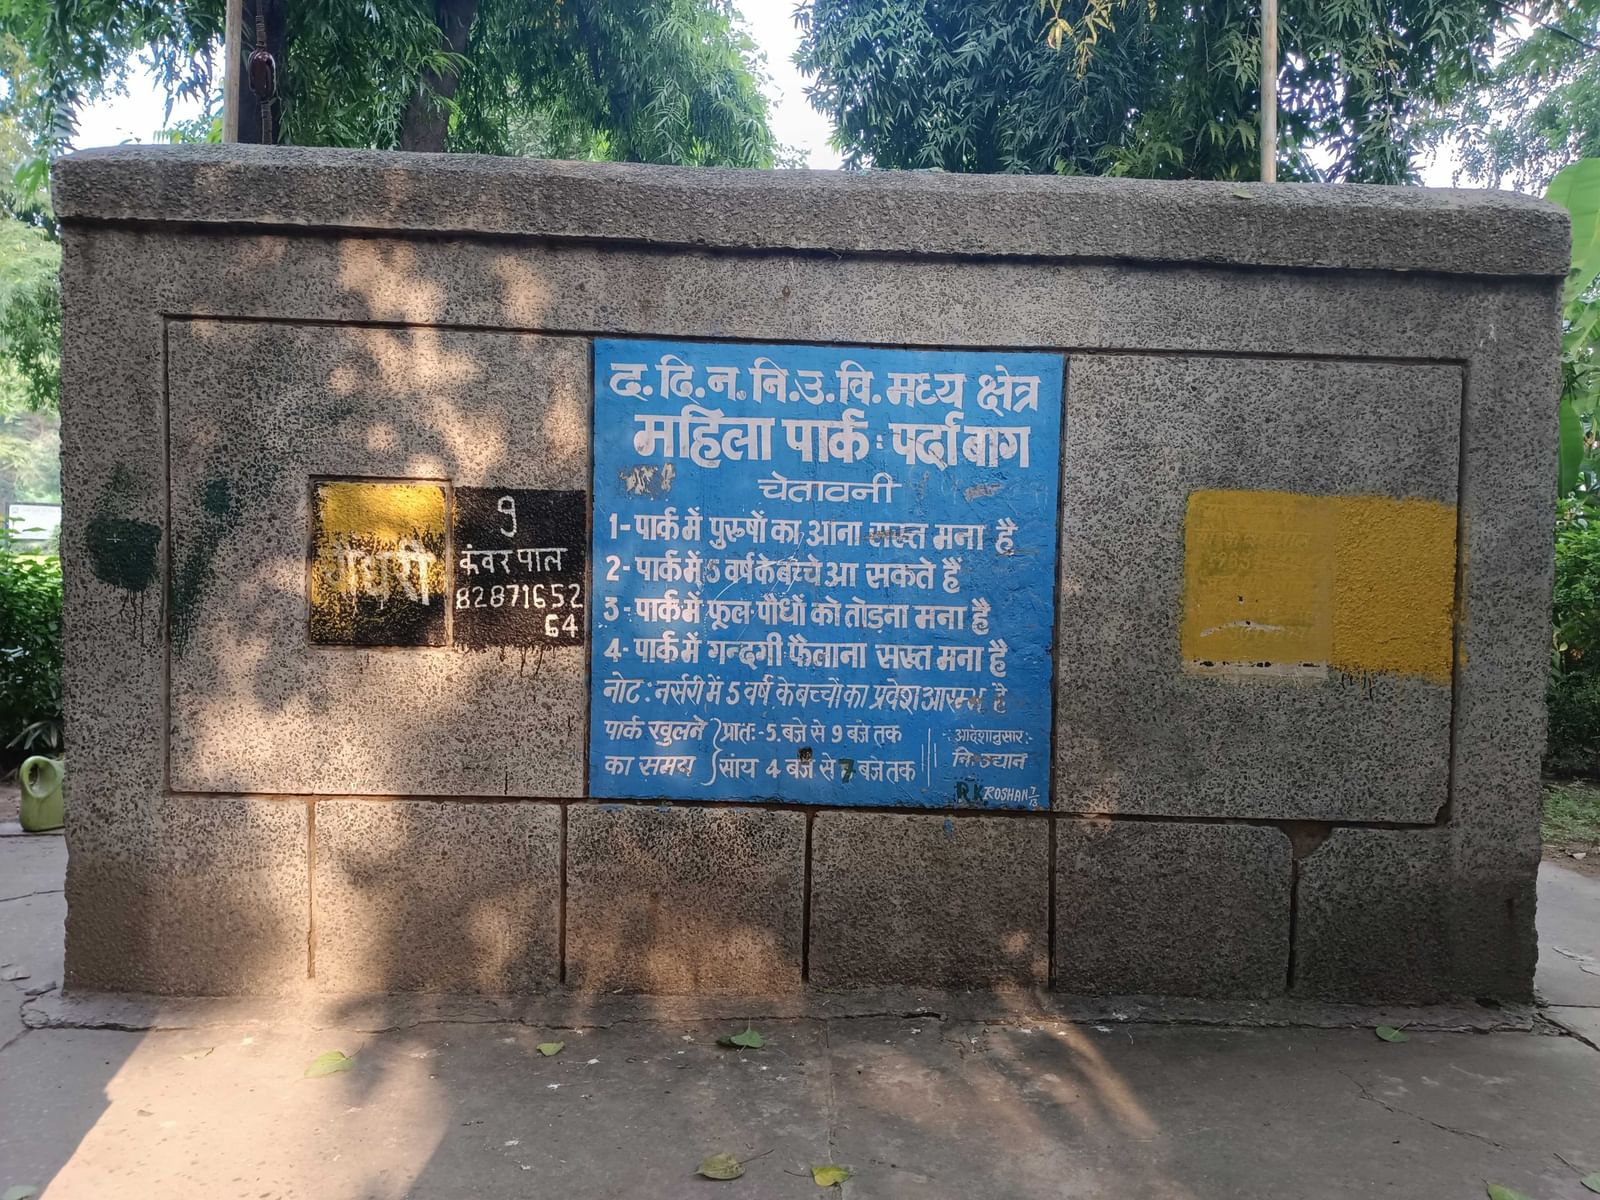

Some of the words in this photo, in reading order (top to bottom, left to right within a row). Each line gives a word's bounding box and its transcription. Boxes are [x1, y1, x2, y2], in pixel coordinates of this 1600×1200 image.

[886, 372, 966, 409] मध्य
[977, 365, 1041, 417] क्षेत्र
[633, 403, 775, 468] महिला
[758, 471, 902, 504] चेतावनी
[634, 507, 679, 541] पार्क
[682, 506, 703, 541] में
[771, 519, 802, 545] का
[806, 520, 862, 546] आना
[868, 522, 929, 549] सख्त
[933, 523, 986, 550] मना
[995, 517, 1018, 555] है
[635, 550, 682, 583] पार्क
[683, 550, 703, 582] में
[725, 552, 755, 584] वर्ष
[824, 561, 859, 588] आ
[866, 557, 937, 590] सकते
[456, 584, 584, 610] 82871652
[635, 589, 680, 623] पार्क
[682, 591, 703, 624] में
[756, 593, 807, 626] पौधों
[811, 595, 842, 627] को
[914, 604, 967, 630] मना
[971, 597, 991, 636] है
[544, 613, 579, 638] 64
[634, 630, 679, 664] पार्क
[682, 631, 702, 664] में
[707, 632, 783, 671] गन्दगी
[788, 633, 867, 668] फैलाना
[875, 644, 933, 672] सख्त
[937, 645, 984, 672] मना
[988, 638, 1008, 678] है
[655, 674, 704, 705] नर्सरी
[706, 674, 725, 704] में
[726, 682, 740, 706] 5
[744, 674, 774, 706] वर्ष
[843, 684, 870, 711] का
[869, 678, 921, 714] प्रवेश
[604, 715, 645, 741] पार्क
[648, 714, 708, 747] खुलने
[782, 717, 808, 743] बजे
[810, 719, 826, 744] से
[831, 725, 843, 743] 9
[847, 719, 869, 744] बजे
[873, 725, 902, 748] तक
[604, 756, 635, 776] का
[638, 756, 697, 777] समय
[719, 753, 759, 779] सांय
[765, 759, 781, 779] 4
[819, 752, 836, 782] से
[857, 755, 883, 783] बजे
[885, 760, 916, 786] तक
